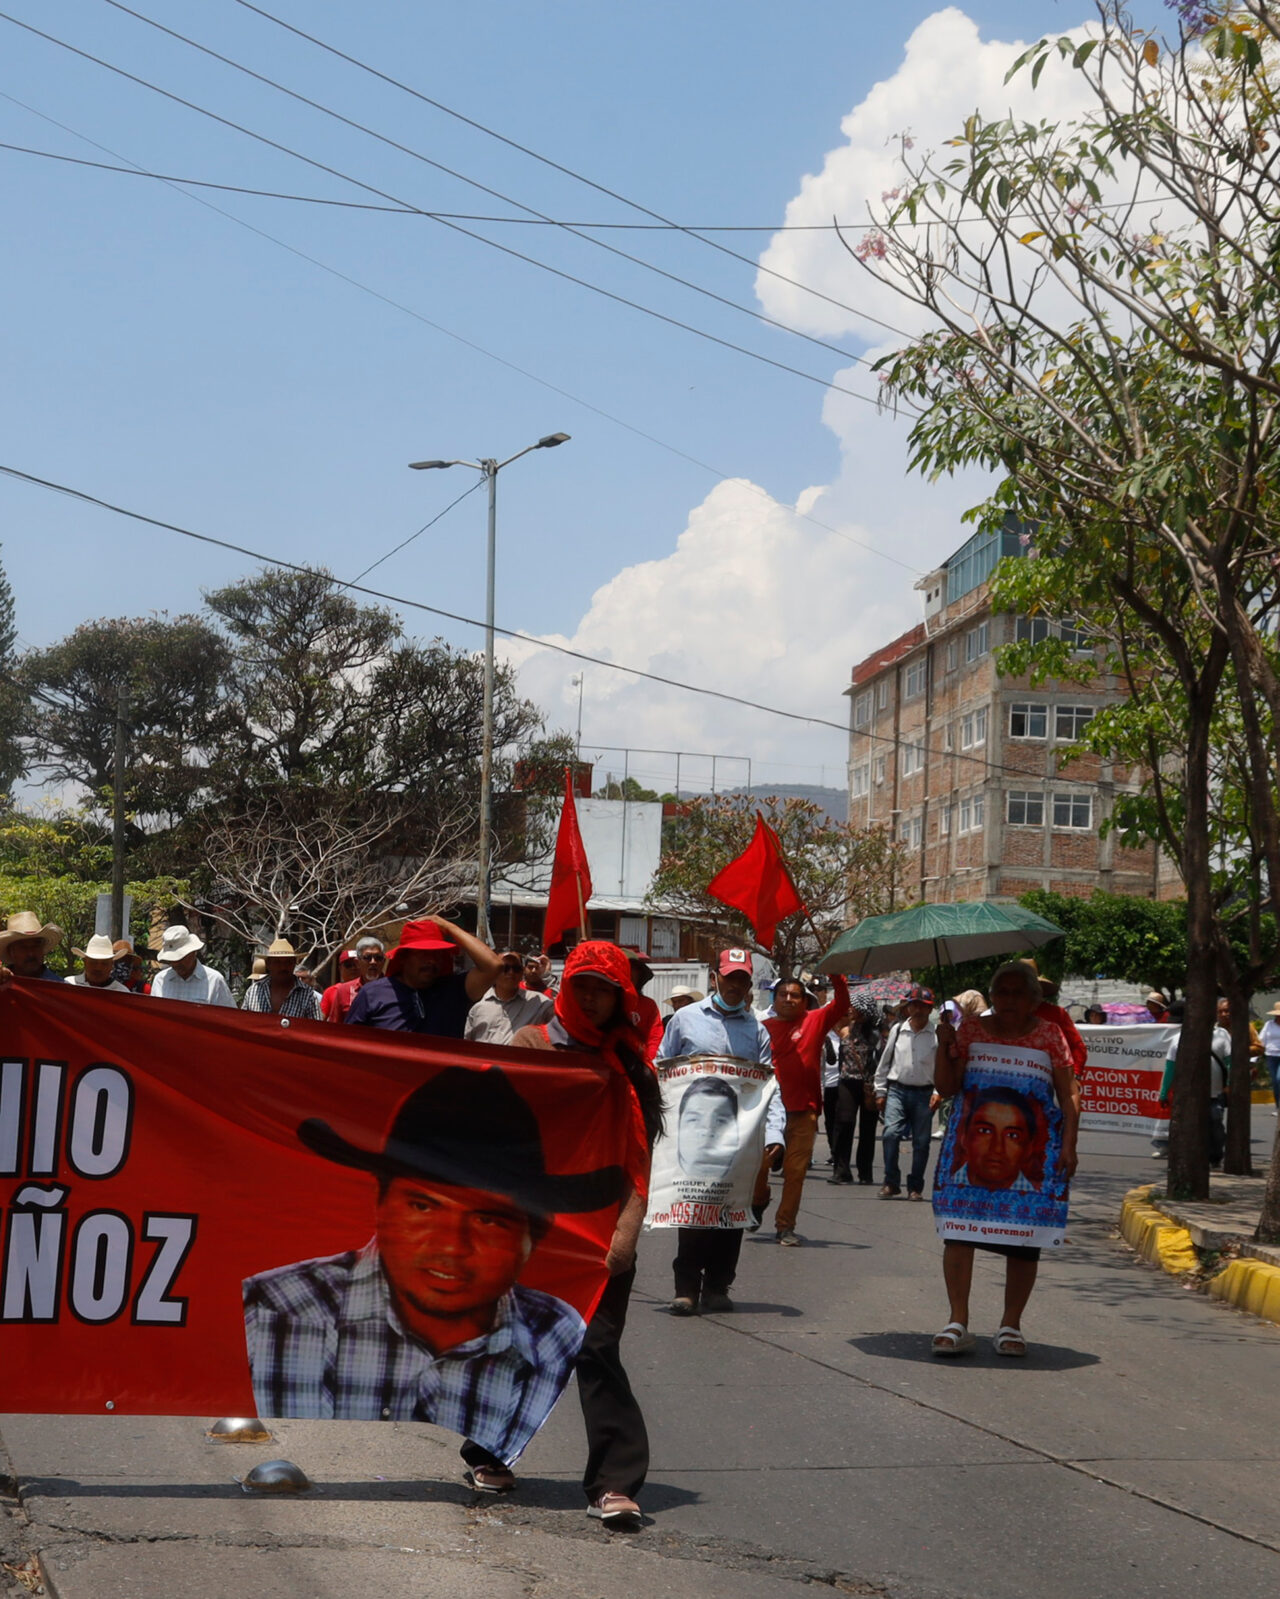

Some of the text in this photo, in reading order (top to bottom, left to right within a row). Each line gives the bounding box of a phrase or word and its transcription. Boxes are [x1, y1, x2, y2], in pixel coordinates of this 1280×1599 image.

[977, 1053, 998, 1063] vivo
[1014, 1057, 1025, 1066] lo
[1131, 1073, 1140, 1085] Y
[1096, 1086, 1162, 1103] NUESTRO
[968, 1223, 978, 1232] lo
[980, 1225, 1035, 1238] queremos!
